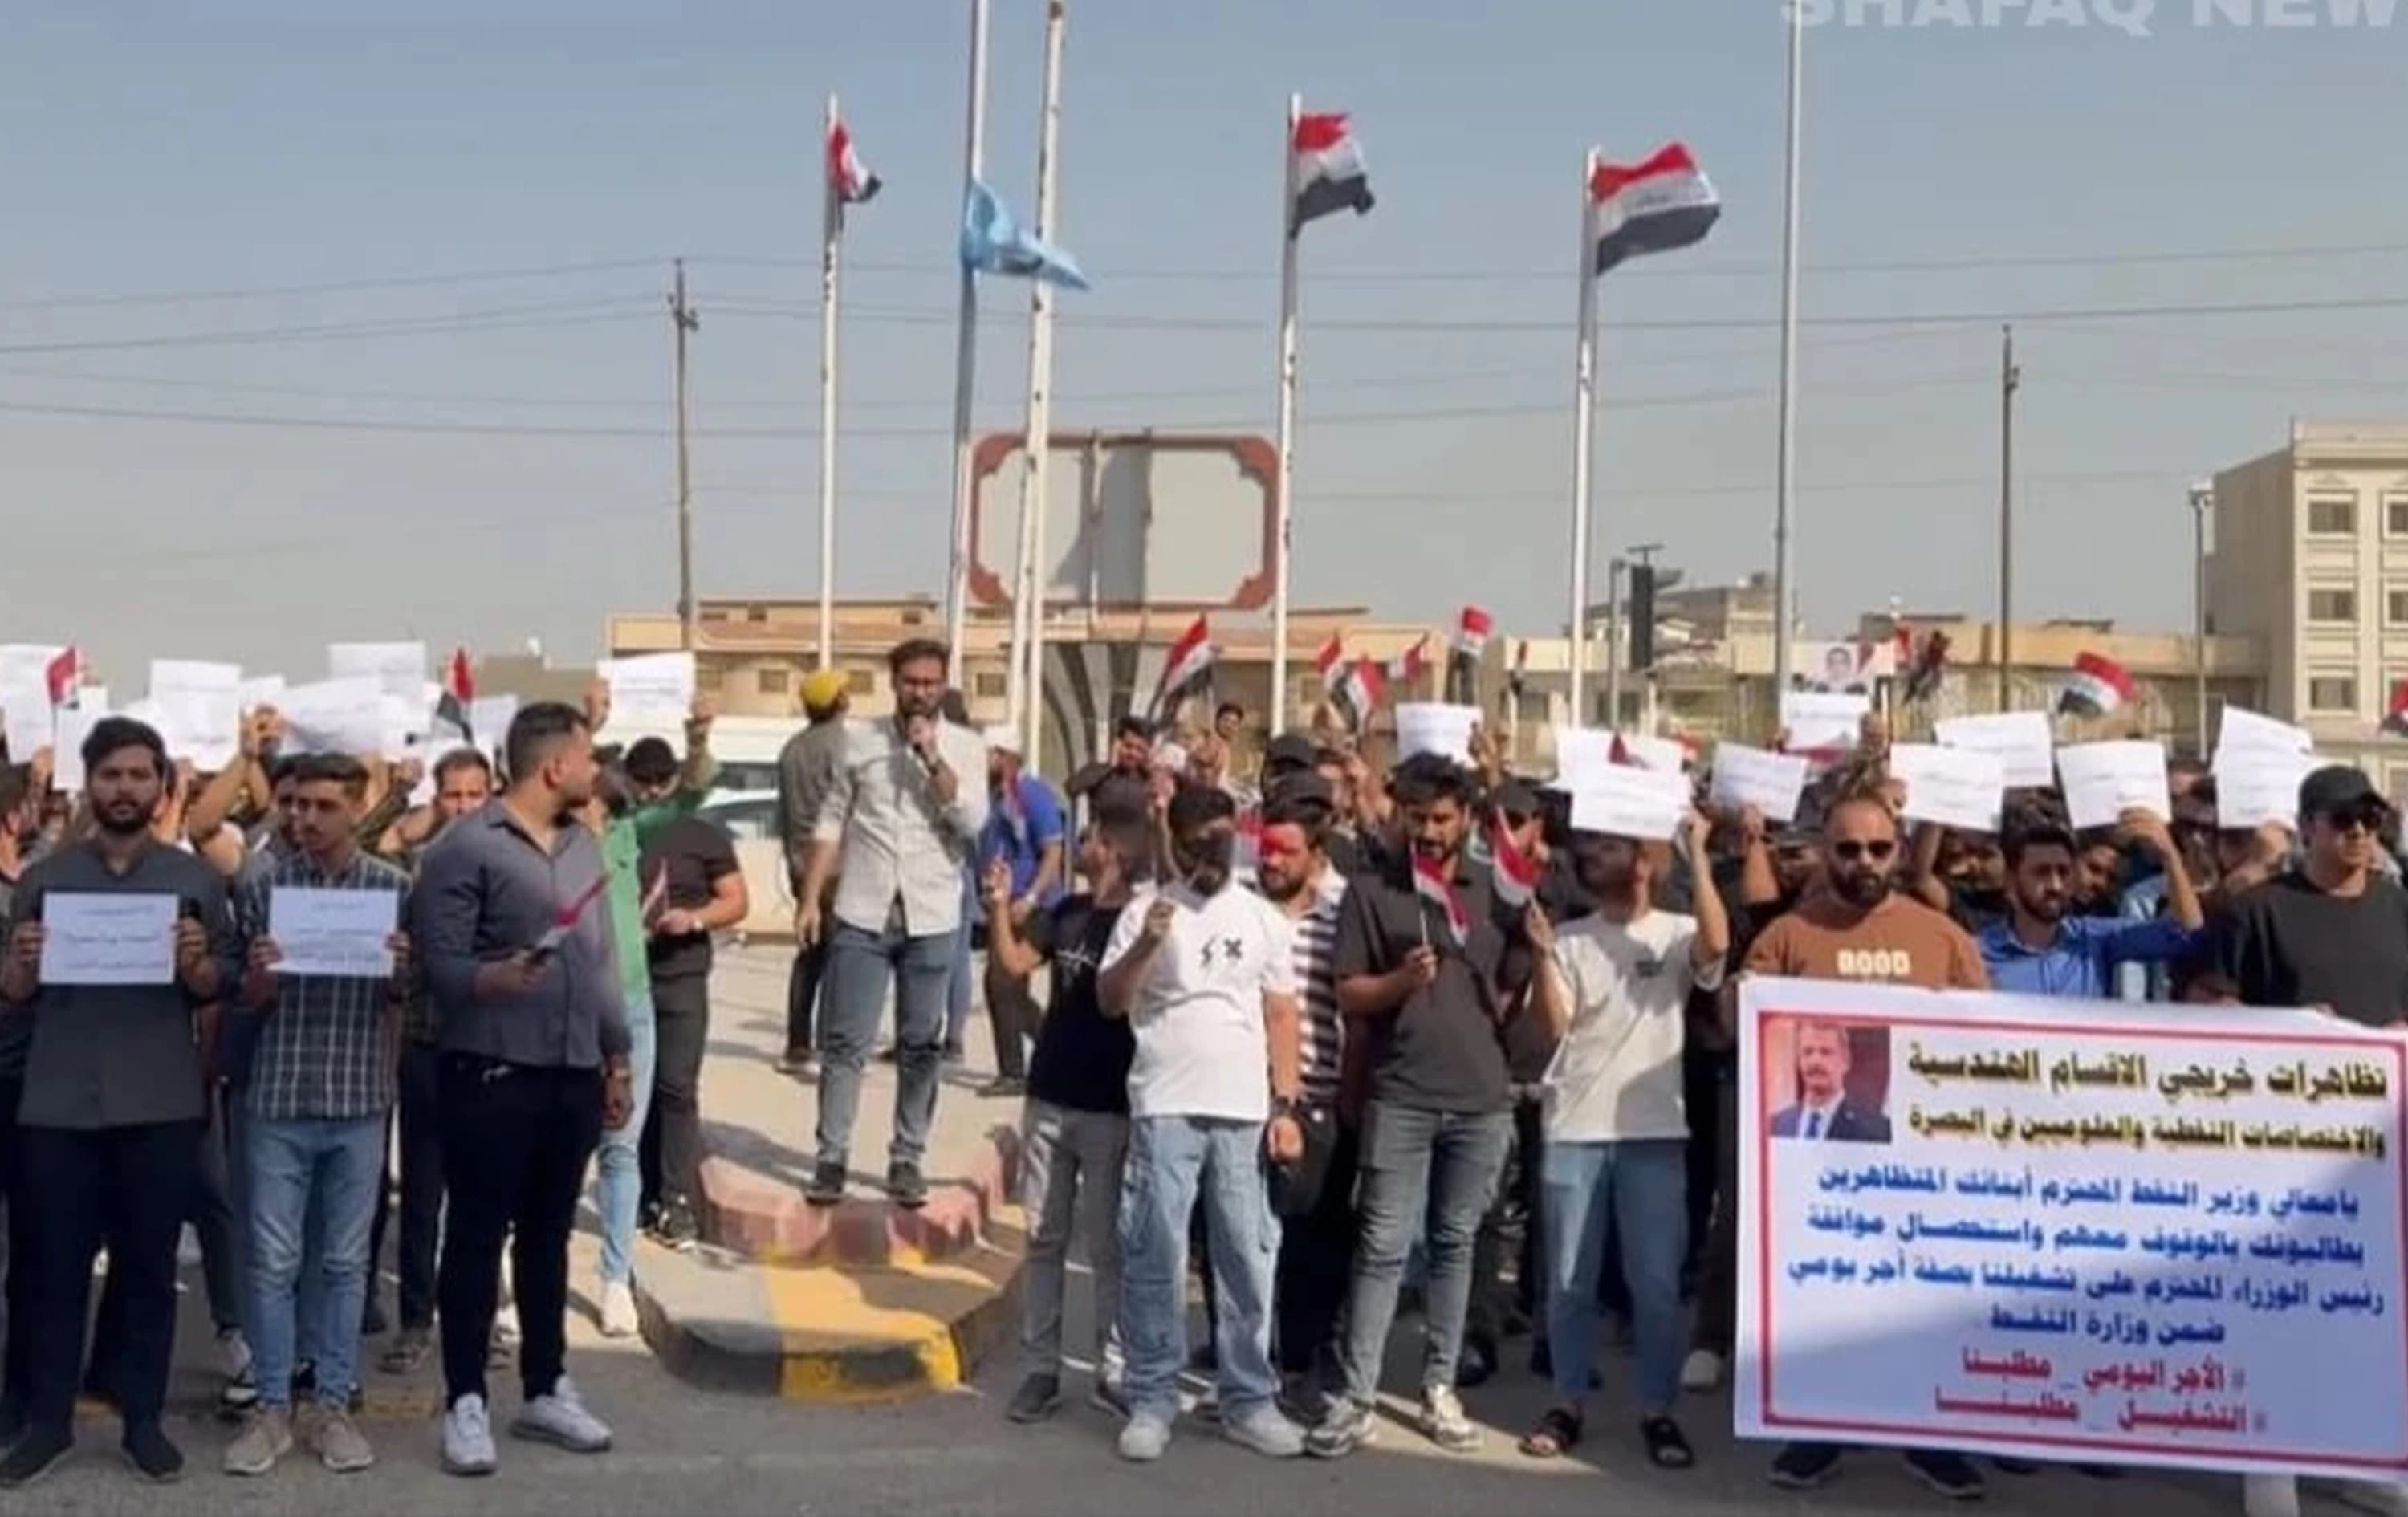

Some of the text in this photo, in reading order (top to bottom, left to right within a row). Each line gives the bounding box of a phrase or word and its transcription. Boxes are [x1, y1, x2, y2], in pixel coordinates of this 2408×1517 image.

[1909, 1042, 2040, 1089] الهندسية
[2158, 1056, 2253, 1105] خريجي
[1909, 1104, 1983, 1137] البصرة
[1819, 1164, 1945, 1194] المتظاهرين
[2041, 1176, 2121, 1206] المحترم
[2131, 1180, 2197, 1206] النفط
[2144, 1274, 2223, 1304] المحترم
[2230, 1277, 2308, 1312] الوزراء
[2319, 1279, 2384, 1316] رئيس
[2087, 1312, 2148, 1345] وزارة
[2157, 1316, 2227, 1345] ضمن
[2084, 1357, 2165, 1394] اليومي
